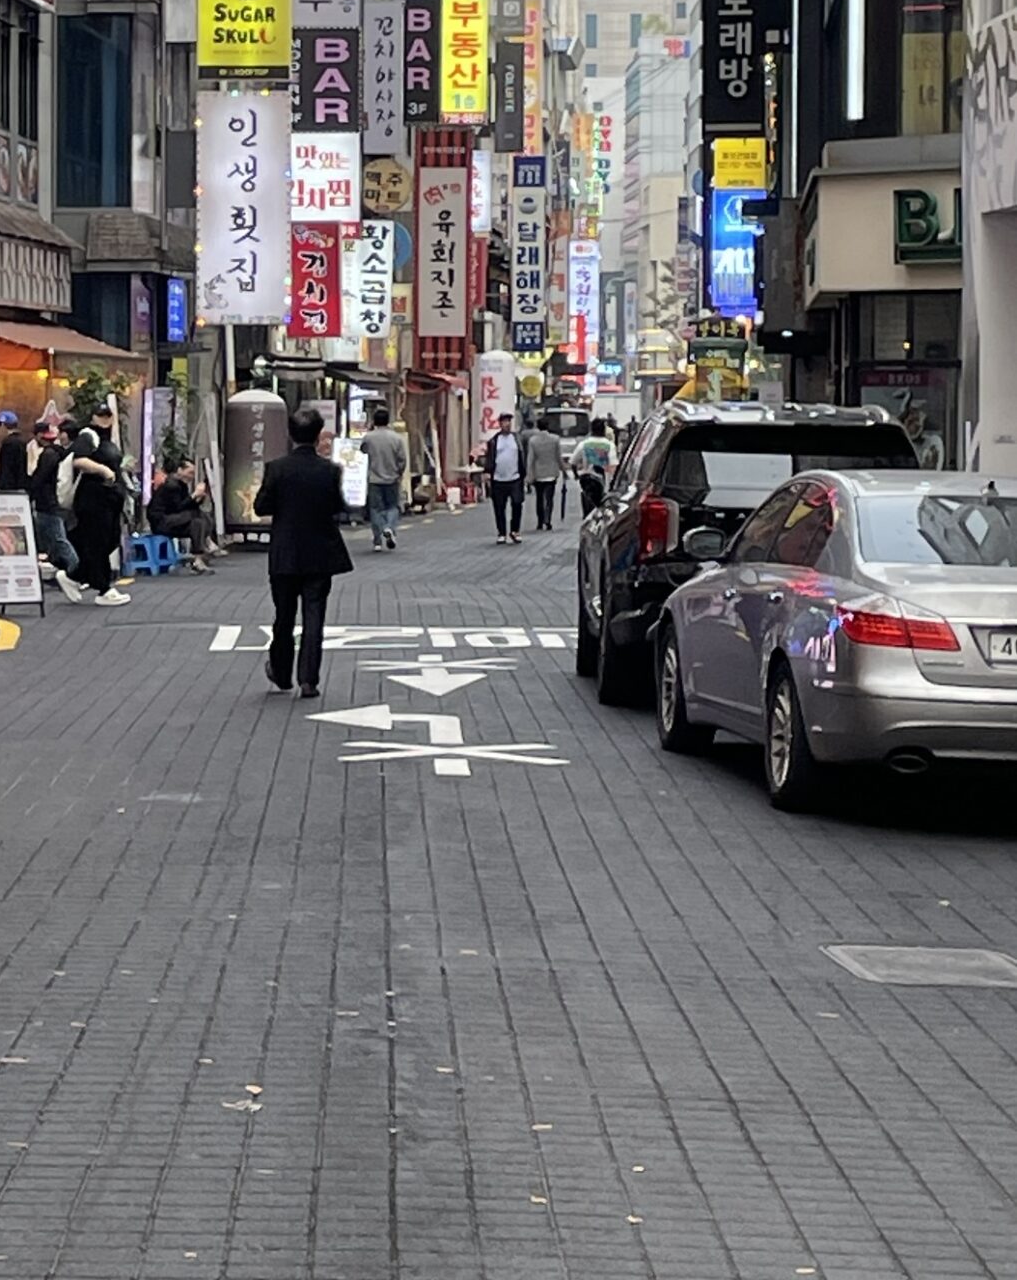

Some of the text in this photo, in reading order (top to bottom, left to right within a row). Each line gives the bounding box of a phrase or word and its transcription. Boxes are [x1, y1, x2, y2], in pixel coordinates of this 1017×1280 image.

[214, 3, 276, 23] SUGAR
[406, 8, 432, 91] BAR
[448, 1, 483, 89] 부동산
[313, 37, 351, 124] BAR
[408, 102, 428, 116] 3F
[289, 179, 352, 211] 김치찜
[295, 144, 351, 170] 맛있는
[227, 109, 261, 293] 인생횟집
[359, 224, 392, 334] 황소곱창
[430, 209, 456, 319] 육회지존
[516, 222, 542, 315] 달래해장
[1000, 636, 1017, 656] 4
